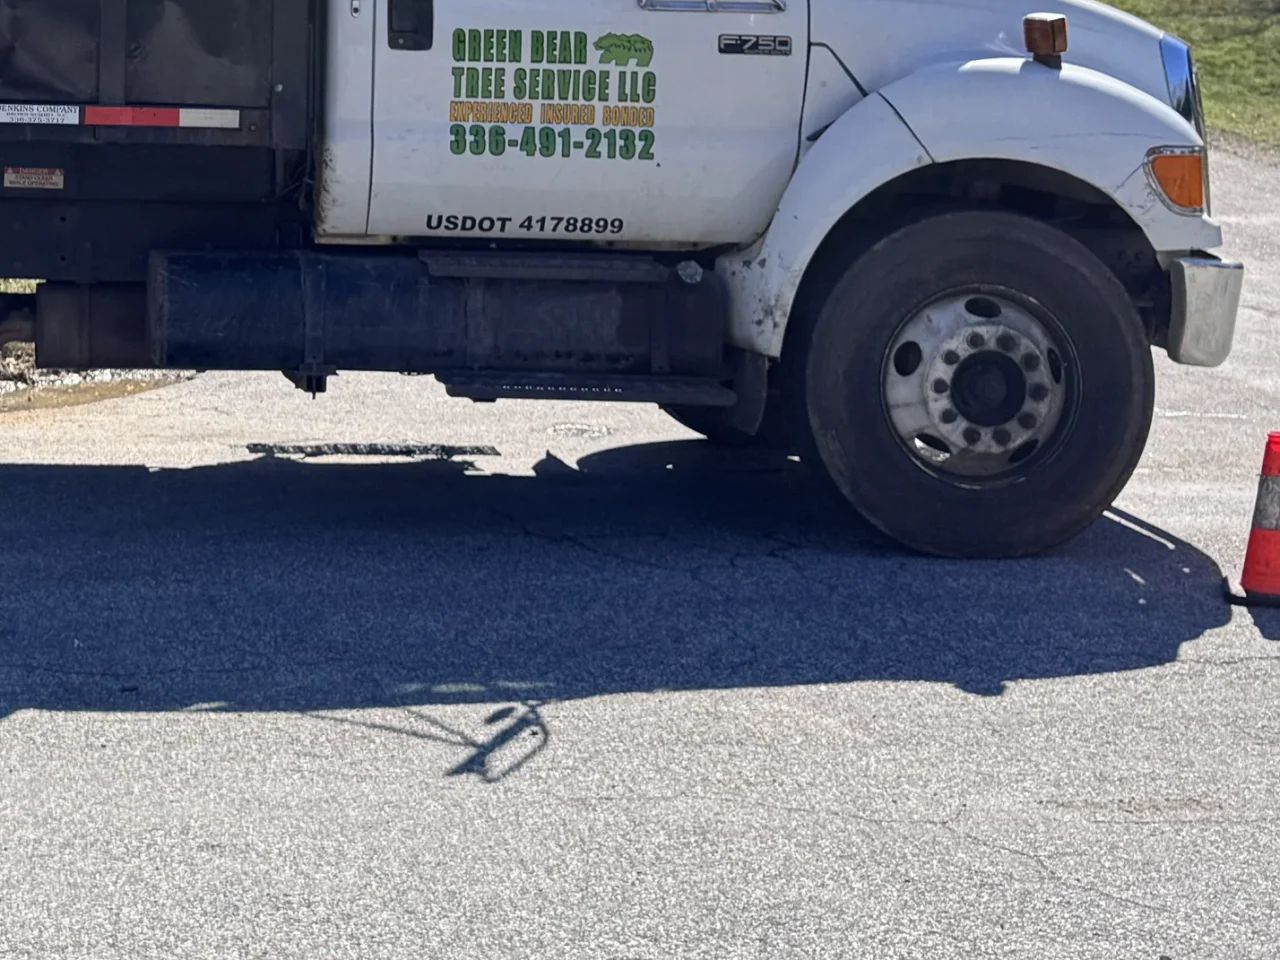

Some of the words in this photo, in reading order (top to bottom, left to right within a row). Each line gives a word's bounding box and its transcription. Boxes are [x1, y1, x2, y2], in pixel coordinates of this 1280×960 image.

[452, 27, 523, 63] GREEN
[530, 30, 588, 65] BEAR
[451, 66, 506, 99] TREE
[513, 67, 610, 102] SERVICE
[617, 70, 656, 104] LLC
[37, 105, 78, 114] COMPANY
[449, 100, 533, 124] EXPERIENCED
[540, 103, 595, 126] INSURED
[602, 105, 655, 128] BONDED
[449, 123, 655, 160] 336-491-2132
[425, 214, 512, 233] USDOT
[519, 215, 624, 234] 4178899
